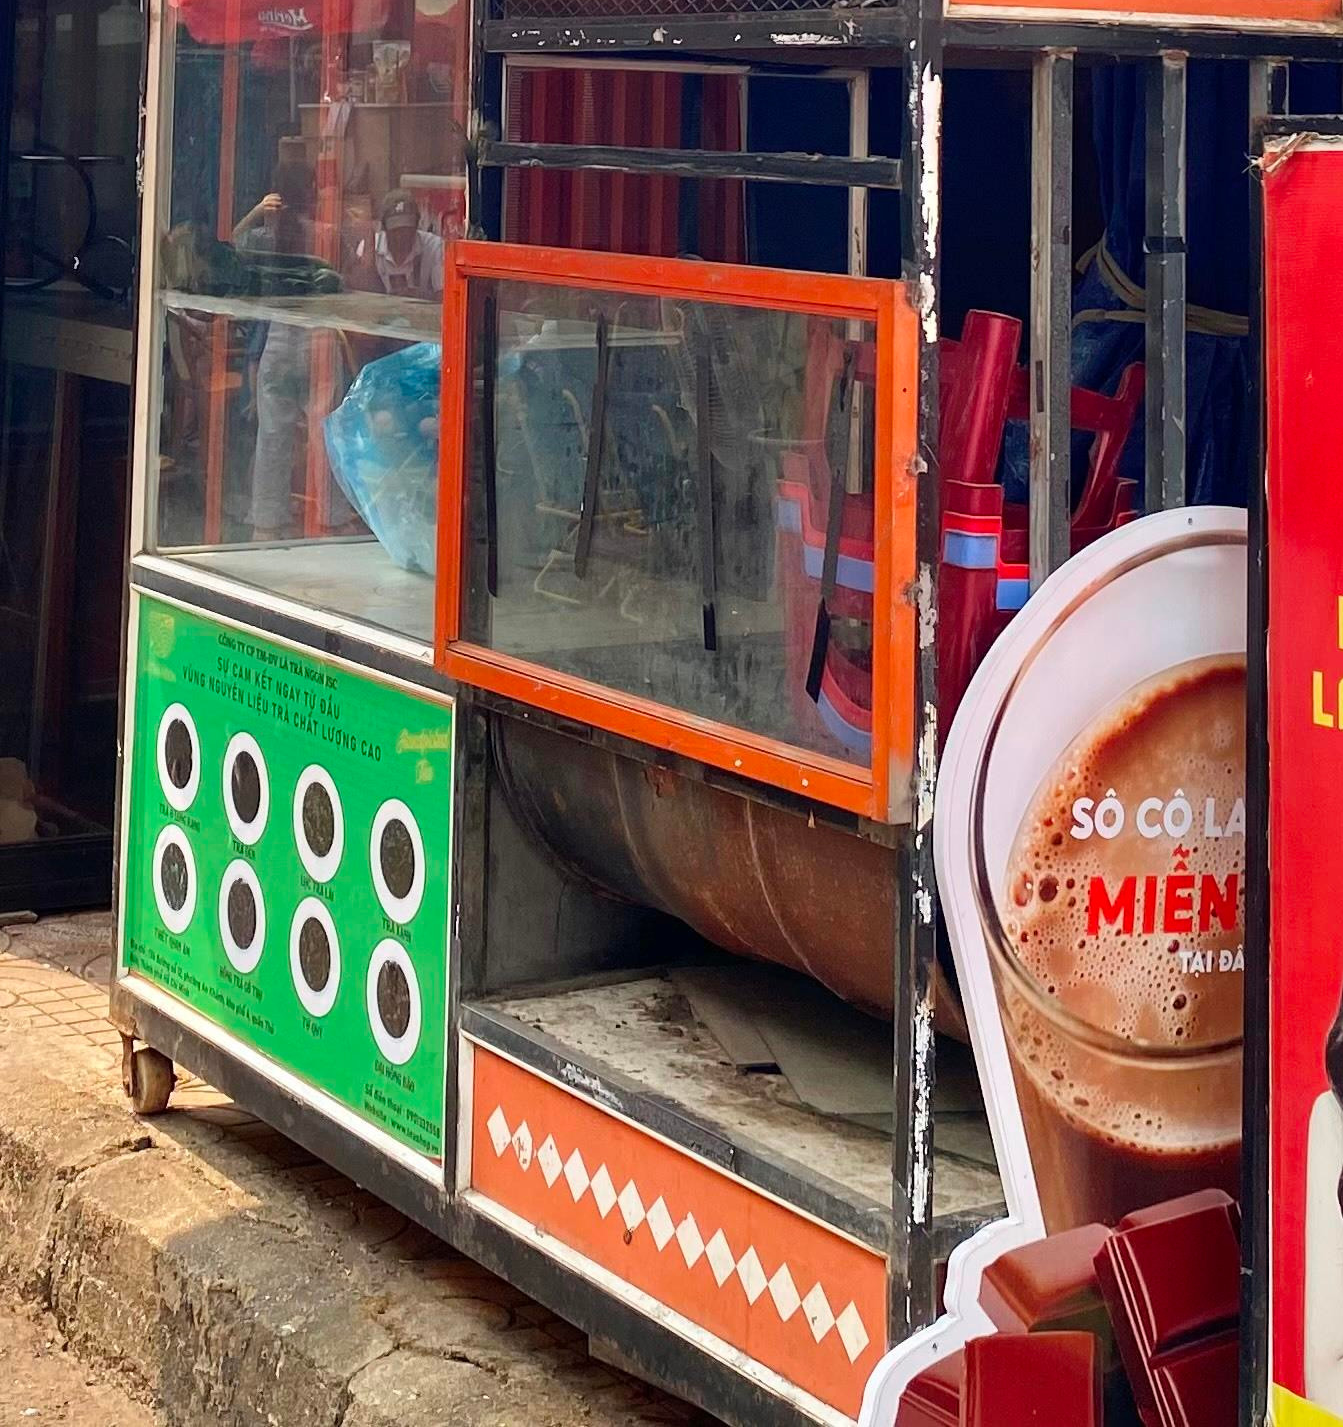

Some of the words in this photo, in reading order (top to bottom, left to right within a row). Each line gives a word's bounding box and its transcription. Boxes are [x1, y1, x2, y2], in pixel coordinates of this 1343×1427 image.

[231, 662, 252, 682] CAM
[254, 663, 273, 693] KẾT
[276, 680, 302, 703] NGAY
[246, 690, 269, 718] LIỆU
[360, 738, 382, 764] CAO
[1070, 788, 1125, 840] SÔ
[1136, 788, 1193, 839] CÔ
[1205, 797, 1246, 838] LA
[1085, 844, 1238, 936] MIỄN
[1179, 950, 1213, 978] TẠI
